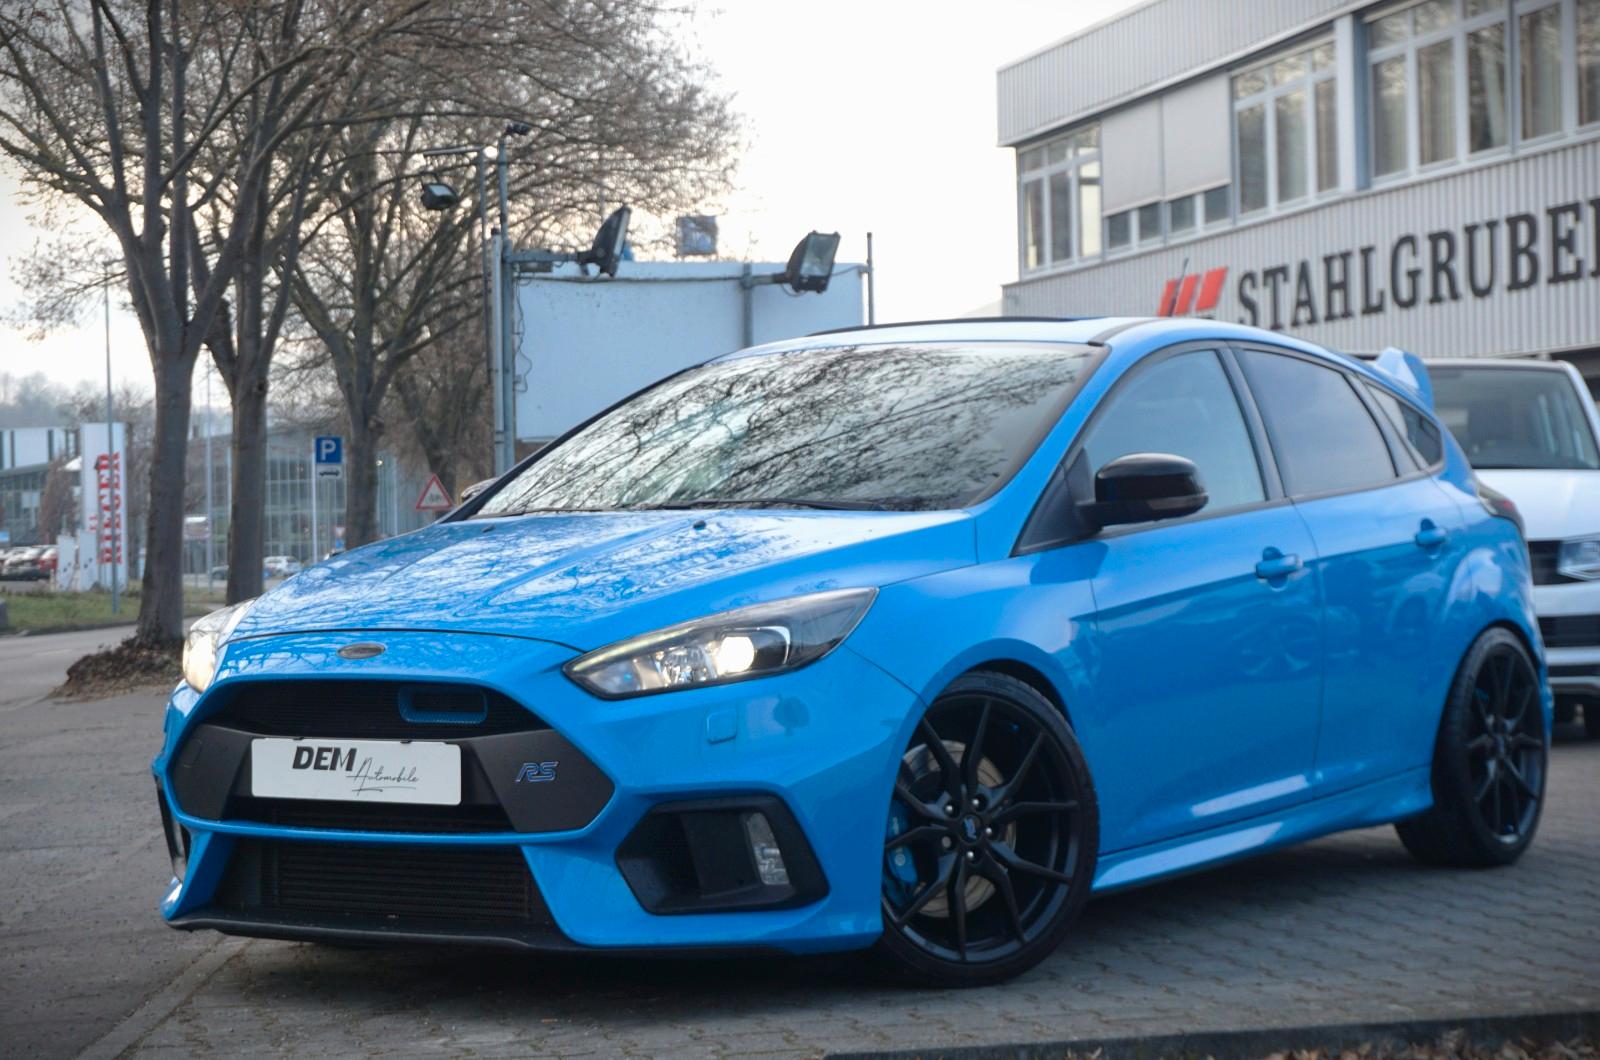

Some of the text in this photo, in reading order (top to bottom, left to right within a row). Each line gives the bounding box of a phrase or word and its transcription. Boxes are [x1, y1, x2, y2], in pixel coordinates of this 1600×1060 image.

[321, 439, 336, 461] P
[292, 745, 357, 772] DEM
[346, 757, 419, 795] Automobile
[515, 761, 559, 782] RS
